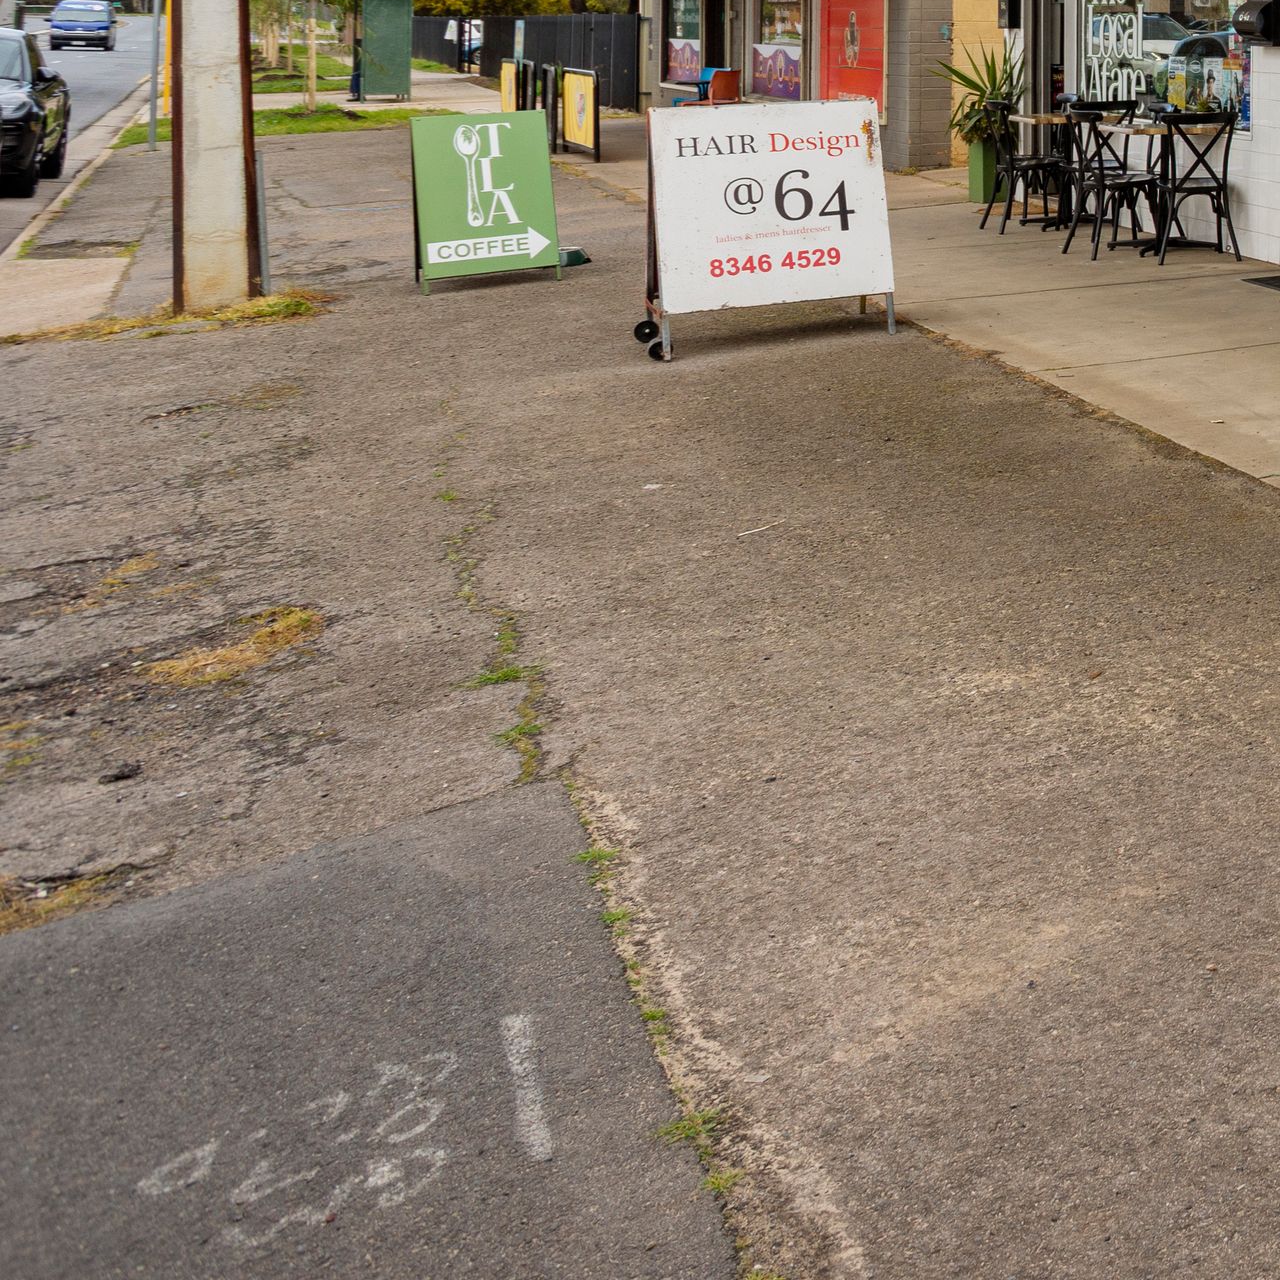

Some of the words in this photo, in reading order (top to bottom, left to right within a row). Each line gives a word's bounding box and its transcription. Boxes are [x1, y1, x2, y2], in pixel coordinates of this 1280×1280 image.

[1087, 4, 1144, 60] Local
[1087, 57, 1147, 114] Afare
[676, 134, 758, 158] HAIR
[768, 131, 861, 157] Design
[724, 177, 764, 215] @
[774, 169, 856, 232] 64
[437, 236, 531, 260] COFFEE
[715, 232, 744, 244] ladies
[745, 232, 753, 241] &
[755, 229, 780, 240] mens
[781, 224, 832, 238] hairdresser
[710, 253, 773, 278] 8346
[781, 247, 842, 270] 4529
